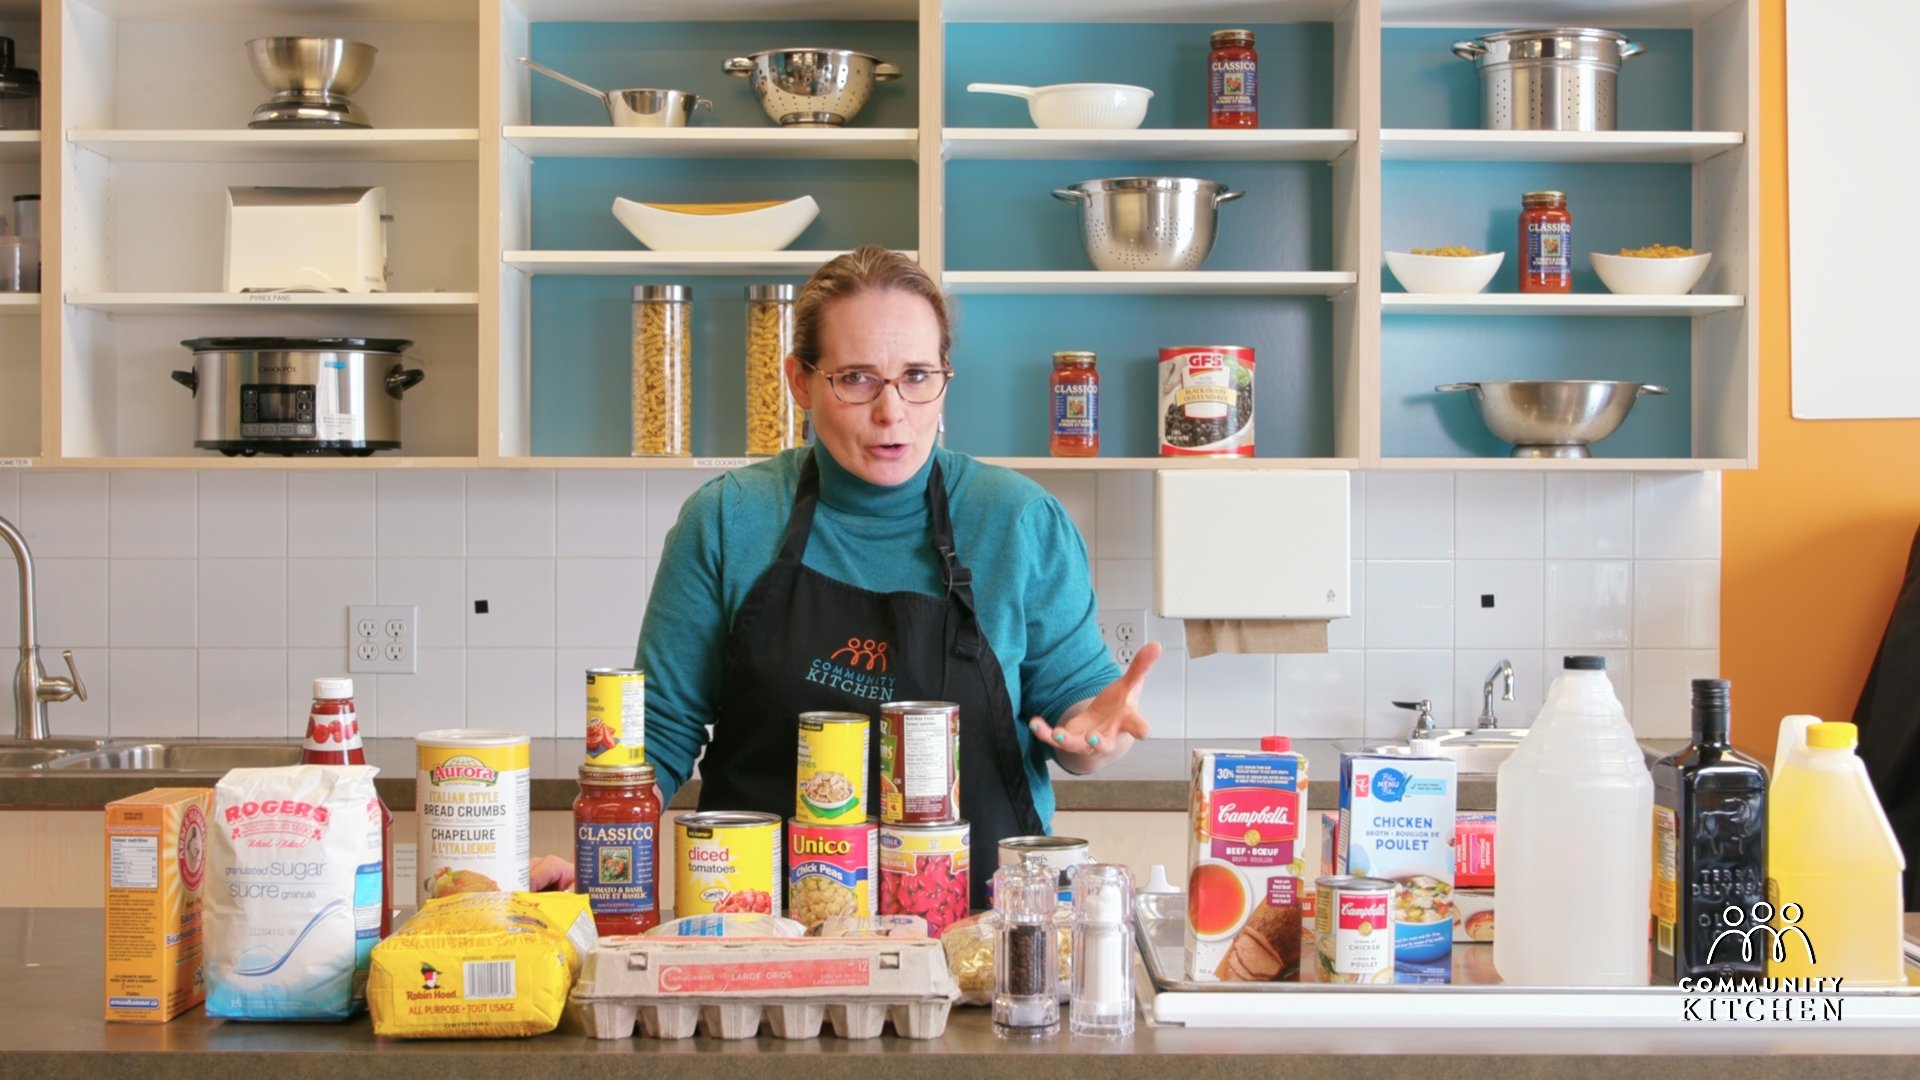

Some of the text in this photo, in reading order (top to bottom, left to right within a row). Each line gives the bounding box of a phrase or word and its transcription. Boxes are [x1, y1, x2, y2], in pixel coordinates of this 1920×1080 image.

[1212, 62, 1255, 70] CLASSICO
[1528, 223, 1570, 232] CLASSICO
[1189, 355, 1222, 367] GFS
[1054, 385, 1098, 394] CLASSICO
[812, 659, 896, 687] COMMUNITY
[806, 668, 894, 701] KITCHEN
[433, 765, 495, 782] Aurora
[1377, 780, 1399, 788] MENU
[430, 791, 499, 803] ITALIAN STYLE
[224, 800, 329, 823] ROGERS
[424, 804, 506, 817] BREAD CRUMBS
[1373, 817, 1433, 829] CHICKEN
[431, 828, 496, 841] CHAPELURE
[578, 826, 653, 841] CLASSICO
[793, 833, 850, 855] Unico
[1376, 839, 1430, 850] POULET
[688, 847, 729, 862] diced
[1226, 847, 1246, 855] BEEF
[225, 861, 327, 880] granulated sugar
[688, 862, 736, 874] tomatoes
[796, 863, 843, 881] Chick Peas
[1701, 868, 1757, 881] TERRA
[228, 883, 316, 900] sucre granulé
[858, 959, 868, 972] 12
[731, 971, 793, 982] LARGE GROS
[406, 990, 456, 1001] Robin Hood
[408, 1002, 515, 1015] ALL PURPOSE TOUT USAGE
